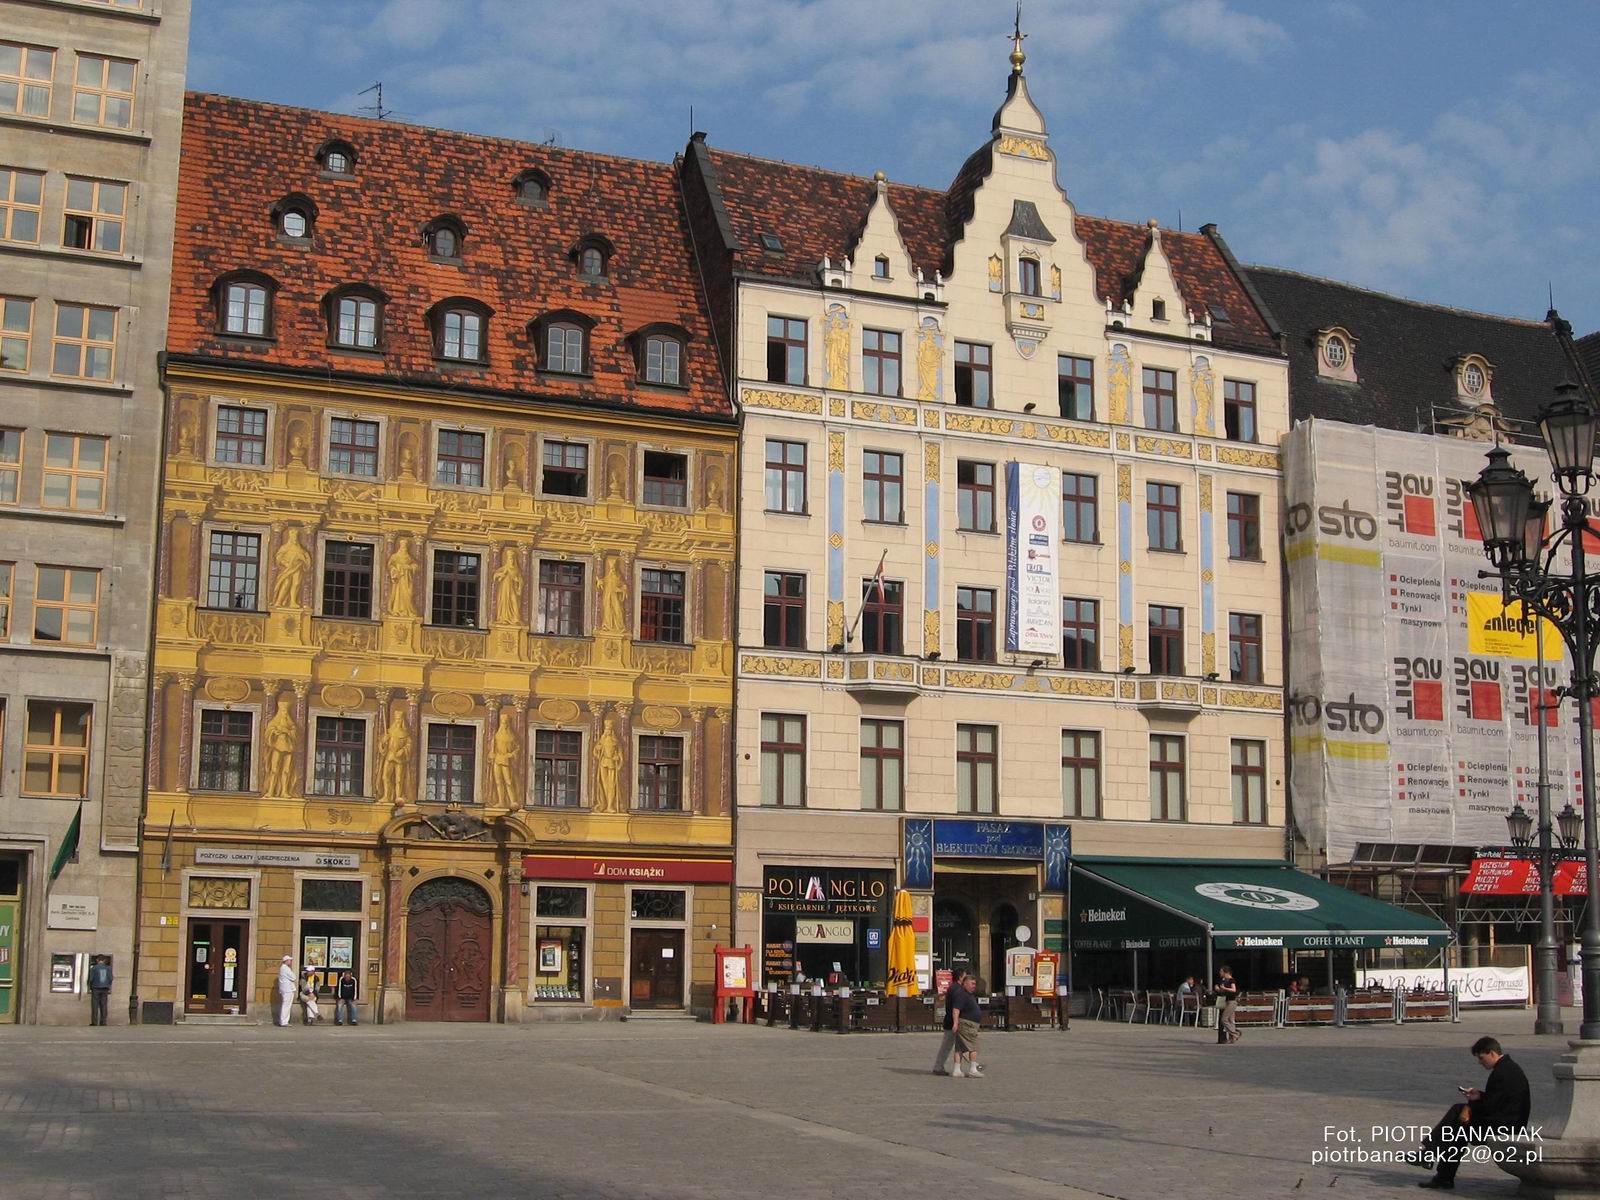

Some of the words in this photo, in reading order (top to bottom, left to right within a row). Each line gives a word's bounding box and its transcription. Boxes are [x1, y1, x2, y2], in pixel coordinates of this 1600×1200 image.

[1319, 499, 1377, 541] sto
[1389, 540, 1437, 552] baumit.com
[1448, 543, 1487, 556] baumit.co
[1400, 576, 1441, 587] Ocieplenia
[1460, 580, 1498, 592] Ocieplenia
[1400, 590, 1441, 601] Renowacje
[1400, 603, 1422, 613] Tynki
[1400, 618, 1442, 629] maszynowe
[1326, 692, 1384, 734] sto
[1457, 724, 1504, 737] baumit.com
[1407, 763, 1448, 773] Ocieplenia
[1467, 762, 1508, 772] Ocieplenia
[1407, 778, 1449, 788] Renowacje
[1467, 776, 1509, 787] Renowacje
[1408, 792, 1430, 800] Tynki
[1468, 790, 1490, 799] Tynki
[1409, 806, 1450, 815] maszynowe
[1469, 804, 1509, 814] maszynowe
[607, 867, 628, 876] DOM
[629, 867, 664, 878] KSIĄŻKI
[778, 903, 826, 912] KSIĘGARNIE
[1088, 908, 1126, 922] Heineken
[1125, 940, 1150, 948] Heineken
[1160, 939, 1178, 947] COFFEE
[1180, 937, 1201, 946] PLANET
[1244, 937, 1283, 946] Heineken
[1303, 937, 1333, 945] COFFEE
[1334, 937, 1365, 945] PLANET
[1392, 936, 1429, 946] Heineken
